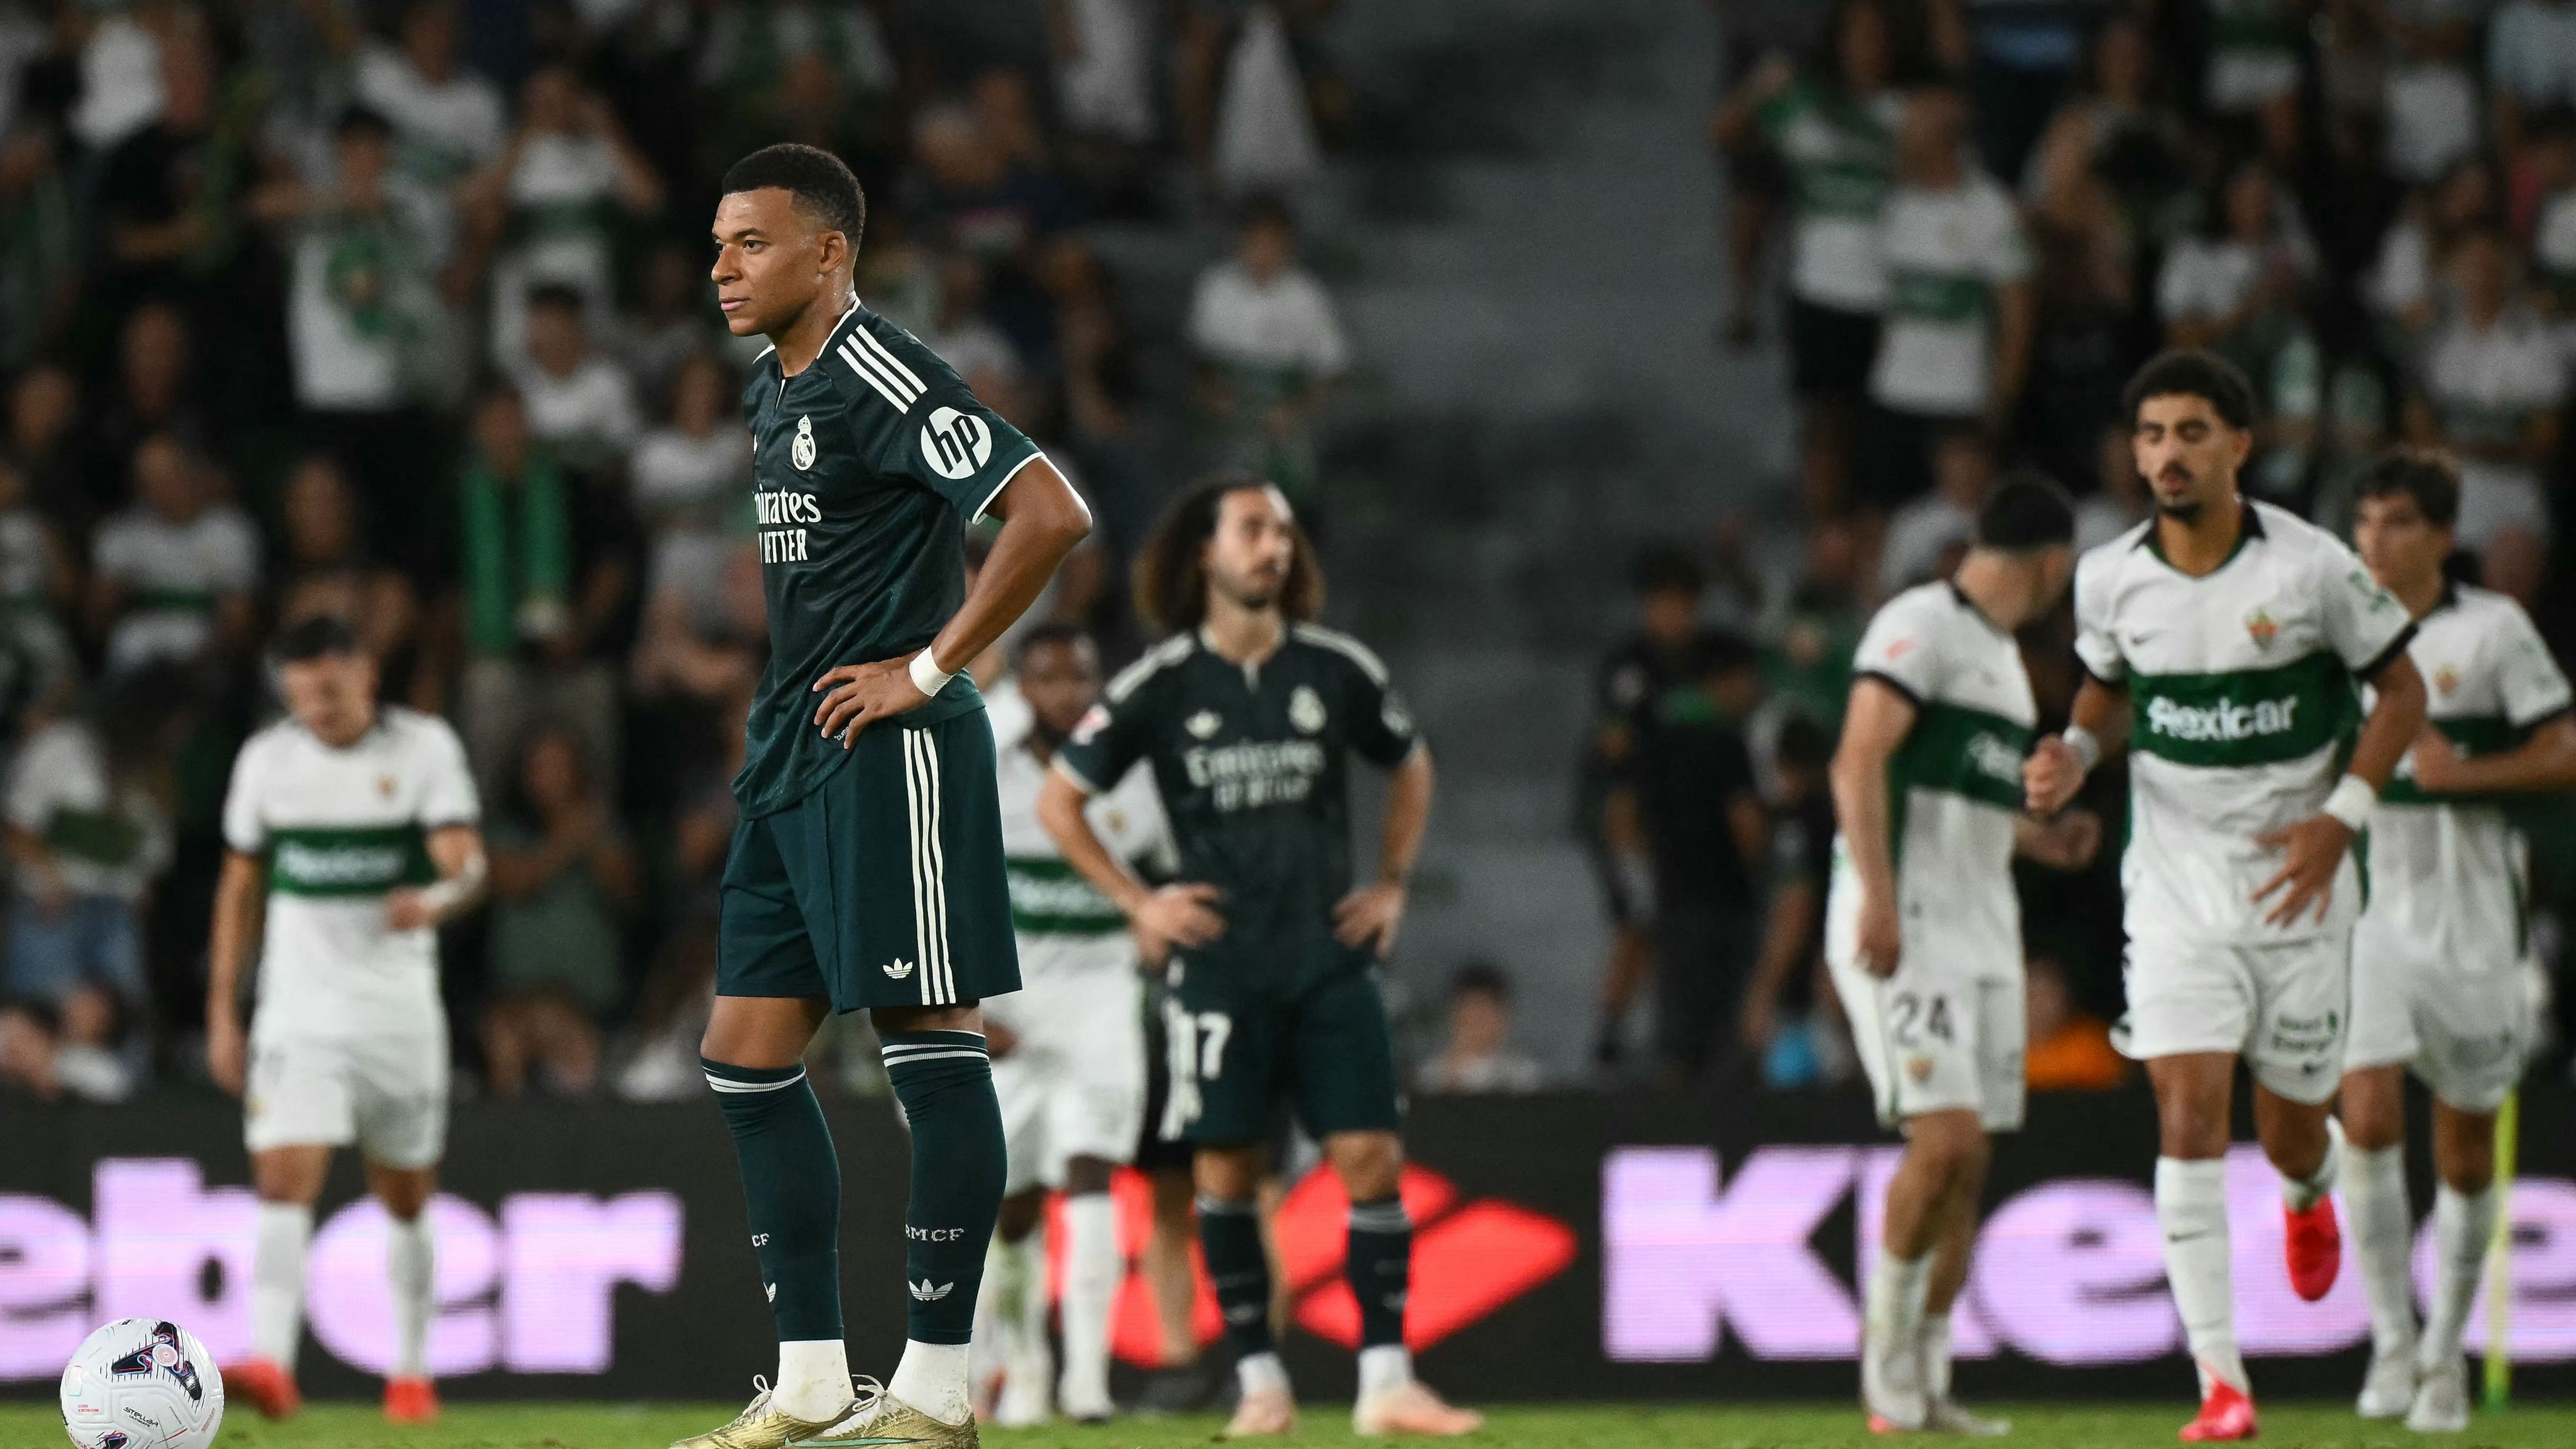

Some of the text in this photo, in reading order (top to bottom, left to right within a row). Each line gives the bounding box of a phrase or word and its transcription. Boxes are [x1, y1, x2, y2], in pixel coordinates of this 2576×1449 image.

[922, 409, 987, 478] hp
[753, 484, 821, 524] mirates
[1173, 1013, 1232, 1080] 17
[1892, 992, 1955, 1046] 24
